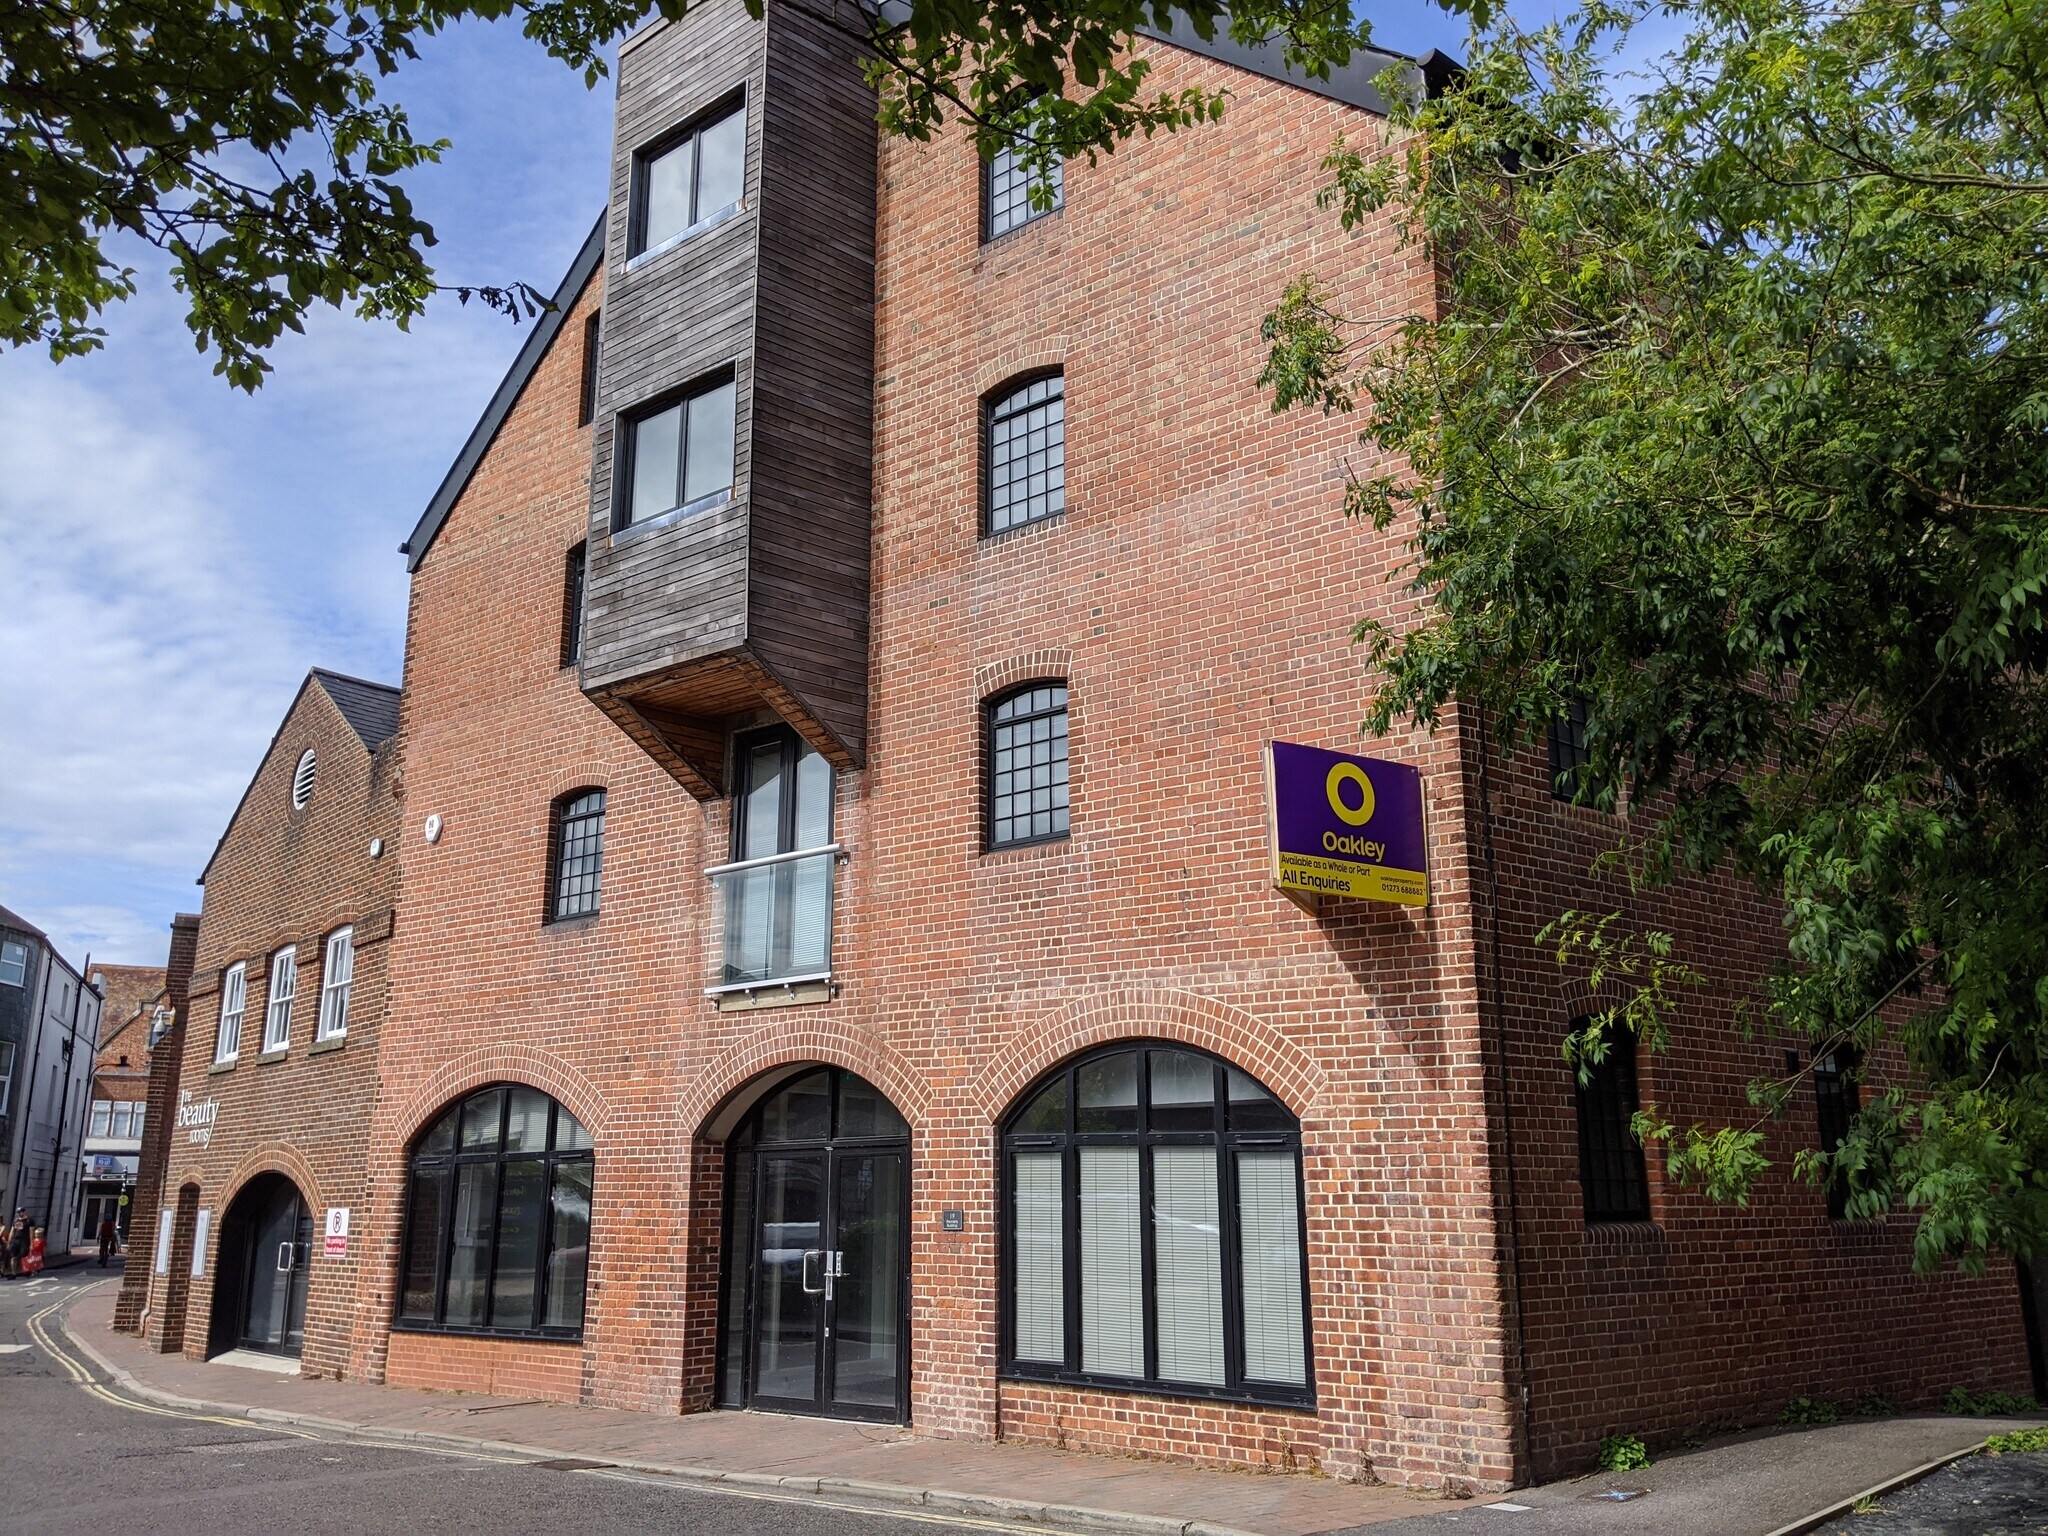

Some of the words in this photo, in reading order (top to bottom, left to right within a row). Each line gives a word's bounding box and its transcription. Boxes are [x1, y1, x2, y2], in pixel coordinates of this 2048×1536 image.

[1322, 831, 1385, 863] Oakley
[1281, 854, 1312, 867] Available
[1313, 860, 1321, 869] as
[1328, 861, 1347, 873] Whole
[1349, 866, 1356, 874] or
[1357, 866, 1371, 877] Part
[1282, 869, 1298, 884] All
[1300, 871, 1351, 891] Enquiries
[1380, 875, 1424, 885] oakleyproperty.com
[1381, 883, 1400, 893] 01273
[1401, 885, 1424, 896] 688882
[178, 1092, 220, 1149] beauty
[190, 1128, 210, 1143] rooms
[331, 1237, 342, 1246] parking
